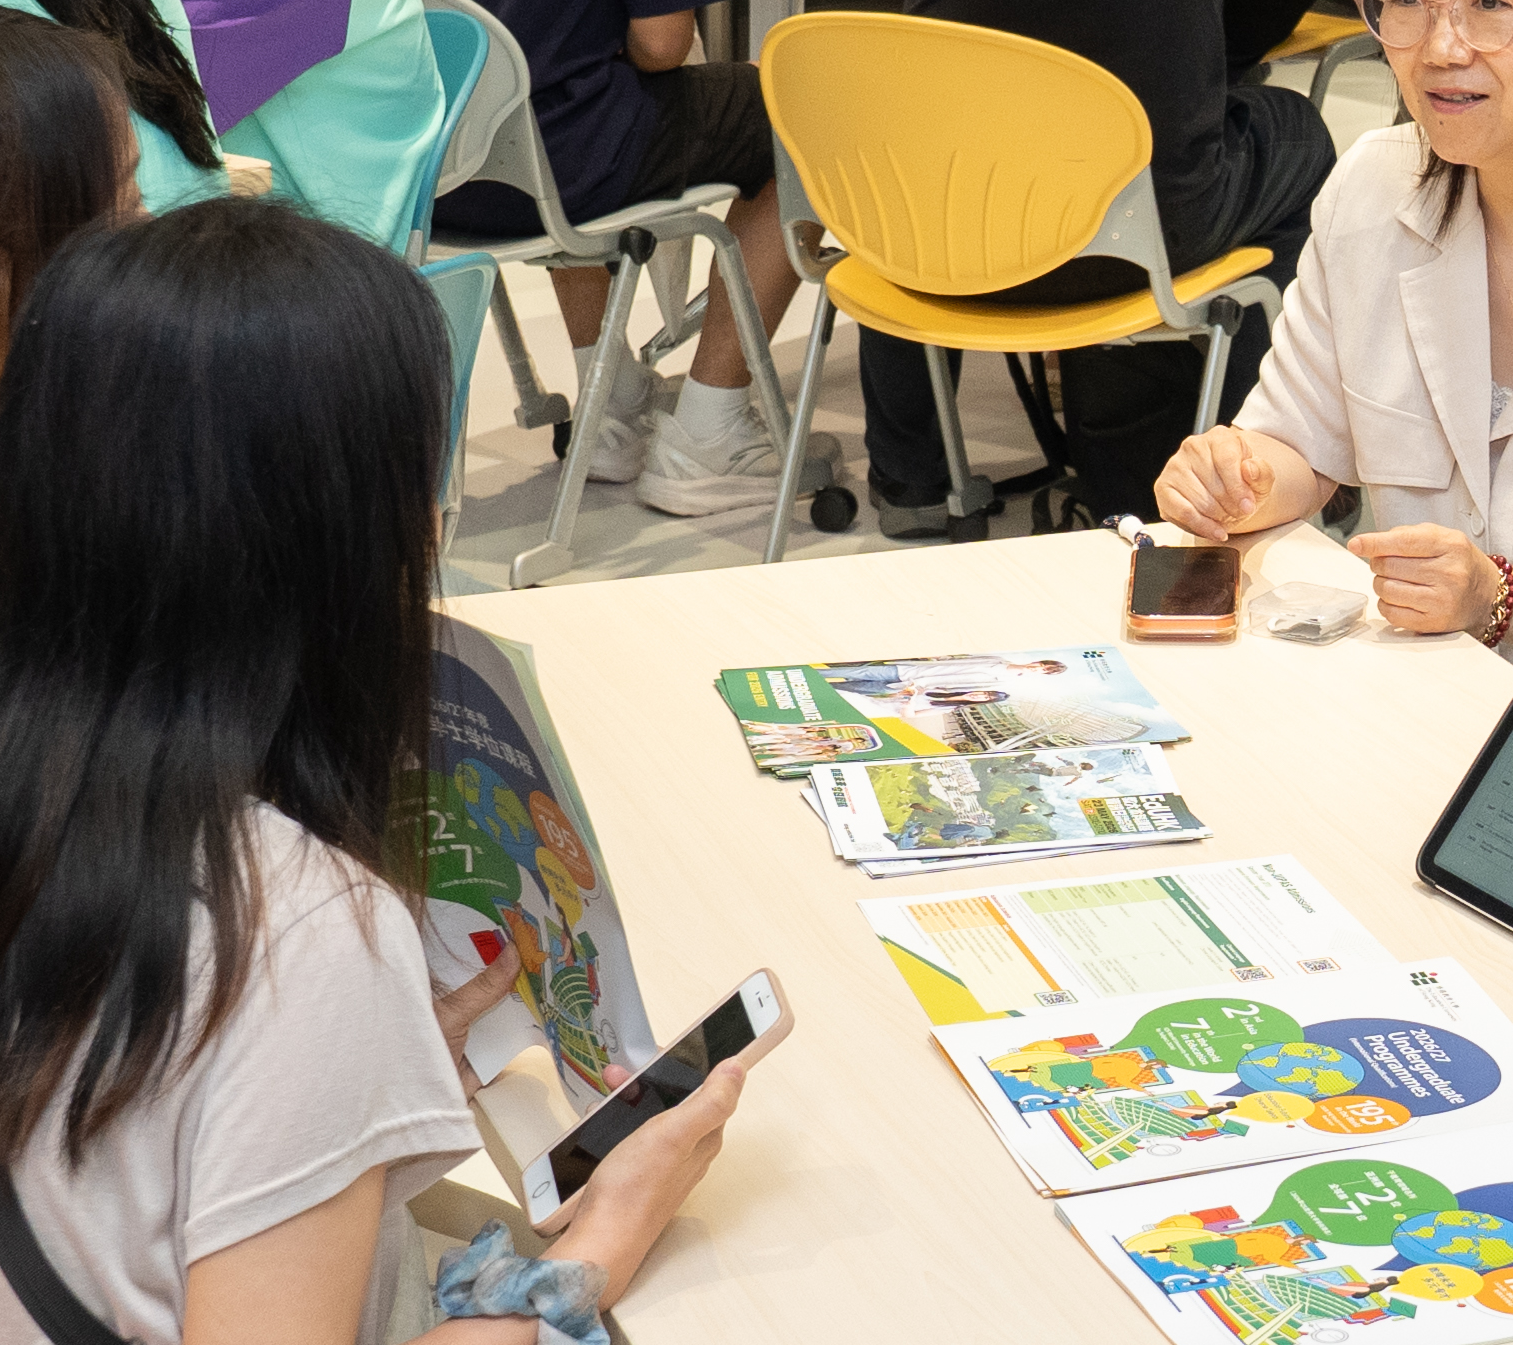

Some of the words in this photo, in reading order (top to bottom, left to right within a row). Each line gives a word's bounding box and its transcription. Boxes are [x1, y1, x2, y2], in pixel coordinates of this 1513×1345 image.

[765, 671, 802, 709] ADMISSIONS
[779, 669, 822, 721] UNDERGRADUATE
[1138, 794, 1184, 833] EdUHK
[1244, 1024, 1257, 1035] Asia
[1409, 1028, 1451, 1062] 2026/27
[1185, 1039, 1209, 1065] Education
[1197, 1037, 1208, 1047] the
[1203, 1046, 1223, 1063] World
[1363, 1035, 1431, 1097] Programmes
[1378, 1031, 1465, 1104] Undergraduate
